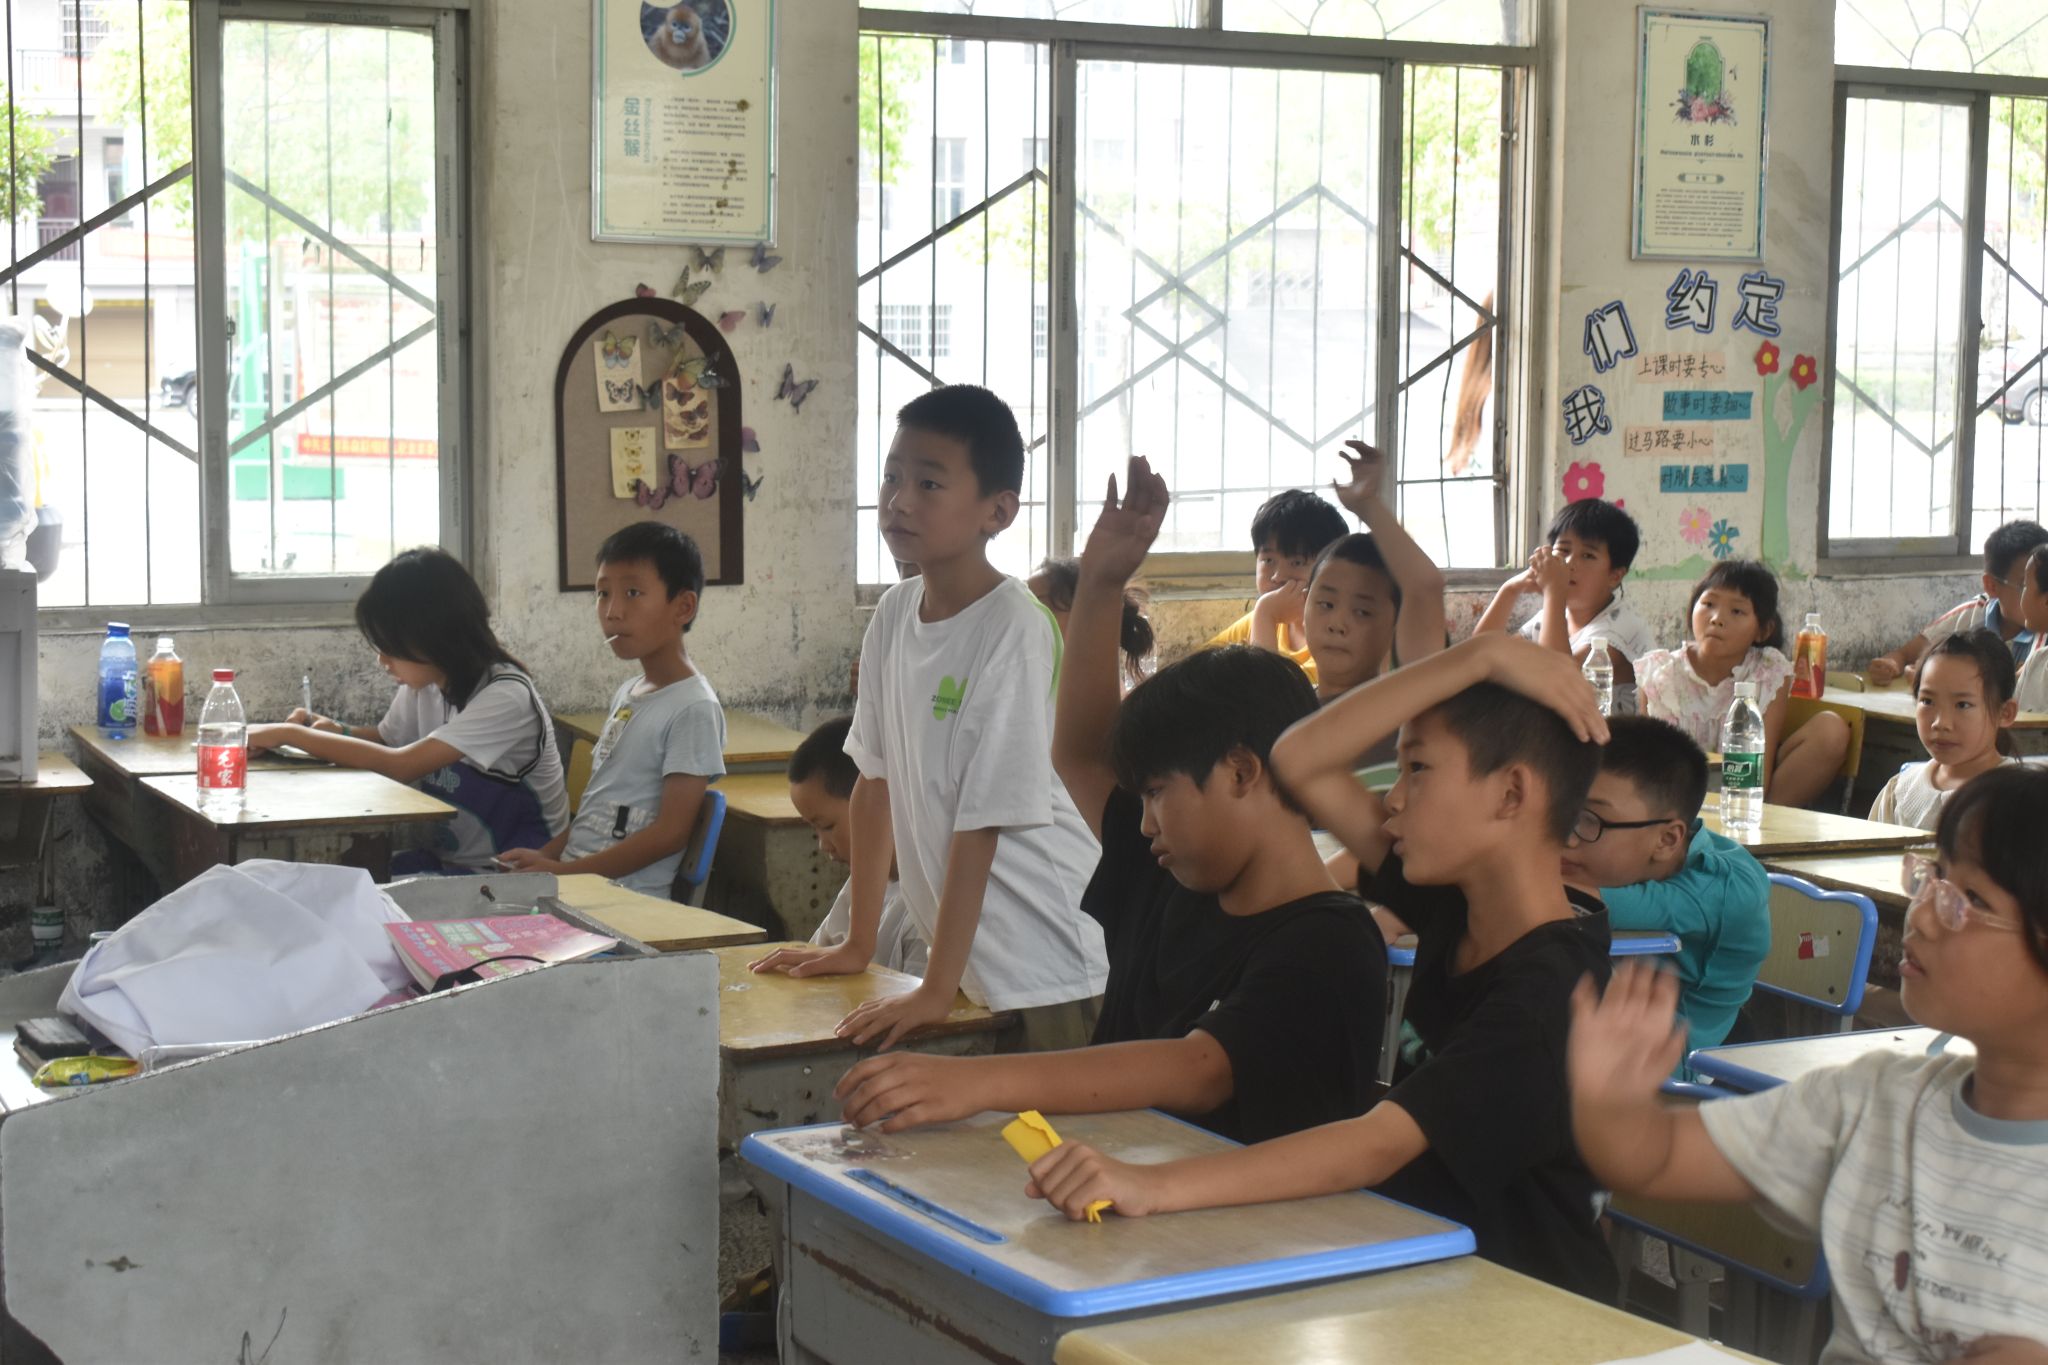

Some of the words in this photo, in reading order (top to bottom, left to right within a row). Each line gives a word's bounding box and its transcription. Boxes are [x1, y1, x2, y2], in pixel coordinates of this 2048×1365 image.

[1638, 353, 1725, 379] 上课时要专心
[1628, 428, 1714, 452] 过马路要小心
